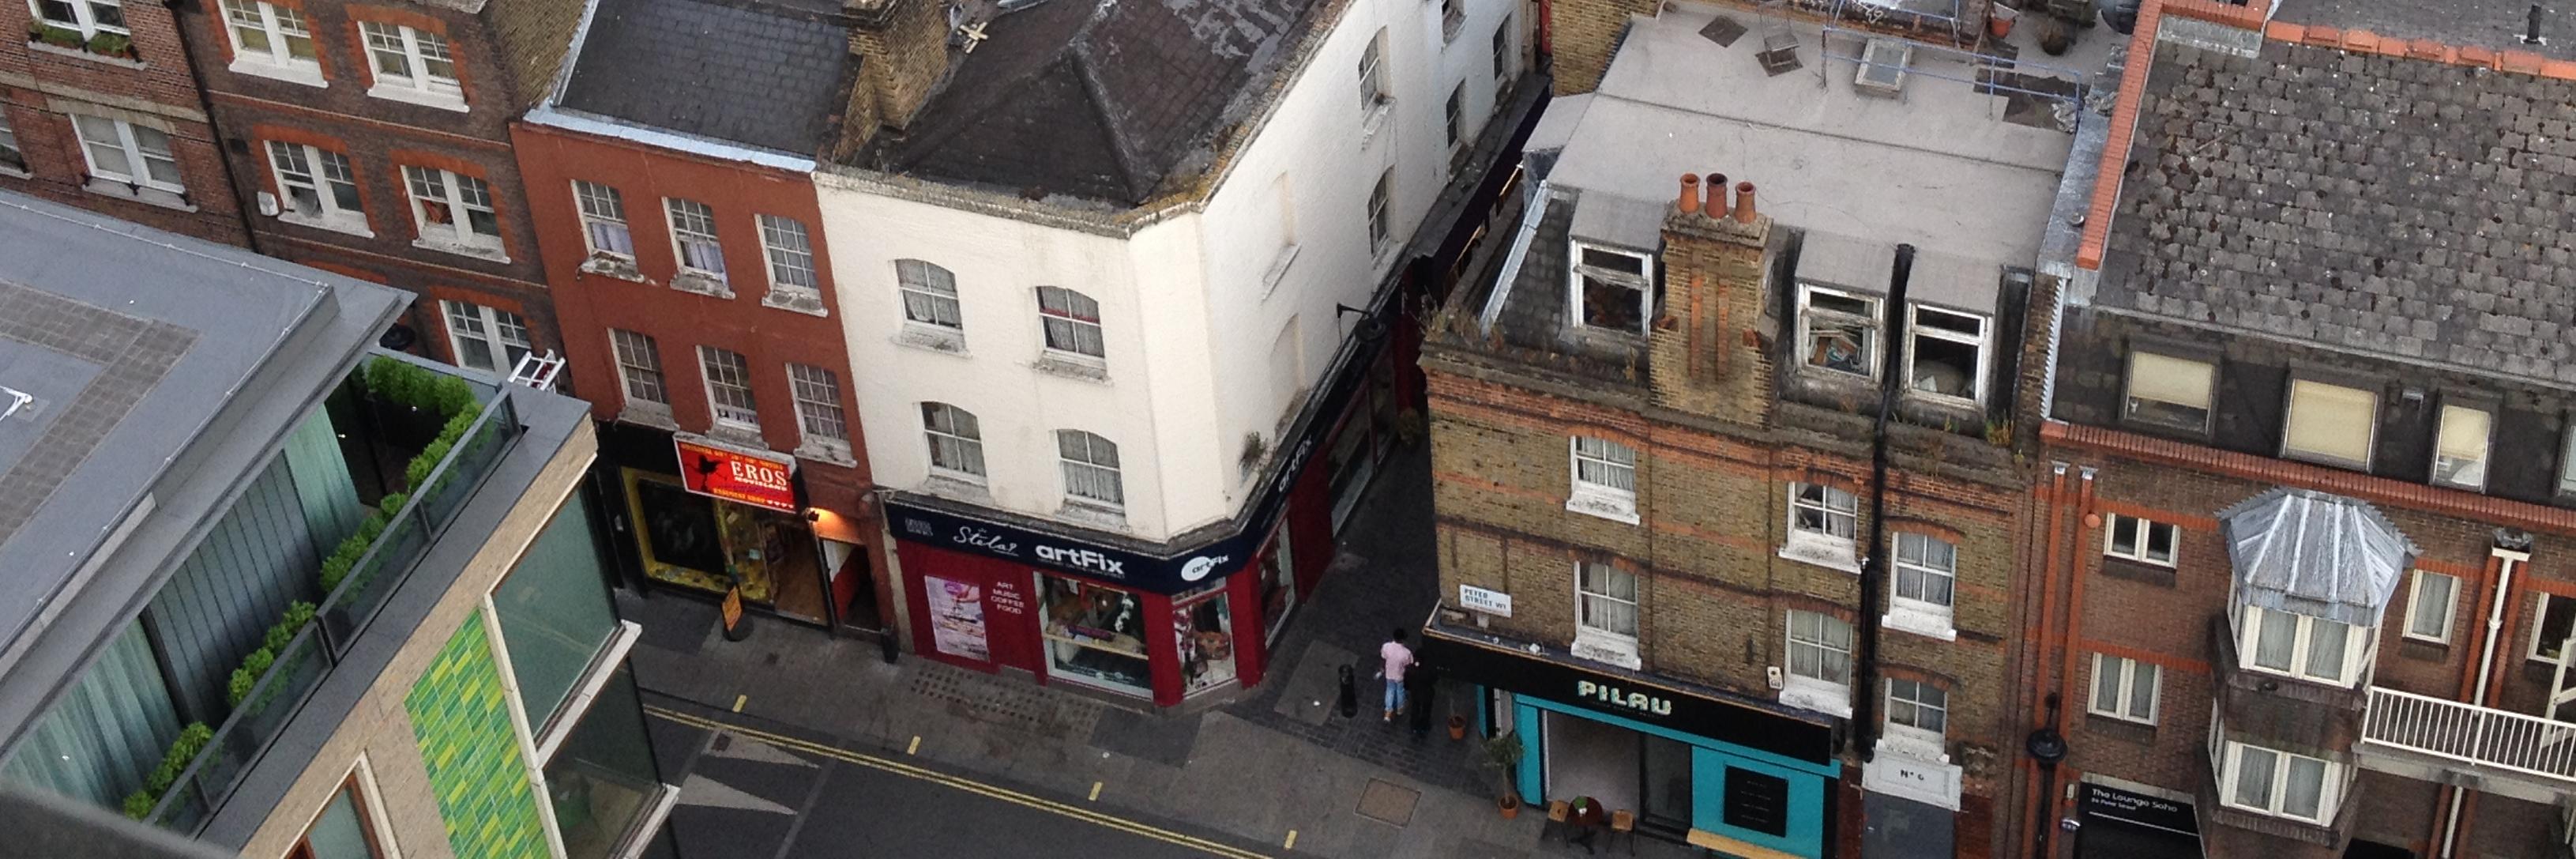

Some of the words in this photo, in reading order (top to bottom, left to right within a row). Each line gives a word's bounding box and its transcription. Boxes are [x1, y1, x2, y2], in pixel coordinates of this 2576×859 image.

[1278, 434, 1311, 492] artFix
[730, 460, 787, 487] EROS
[1036, 544, 1124, 575] artFix
[997, 581, 1013, 590] ART
[992, 588, 1021, 600] MUSIC
[1465, 588, 1488, 599] PETER
[990, 595, 1025, 608] COFFEE
[1465, 595, 1492, 607] STREET
[997, 604, 1022, 615] FOOD
[1578, 680, 1672, 715] PILAU
[2091, 788, 2110, 798] The
[2112, 793, 2149, 808] Lounge
[2152, 801, 2178, 812] Soho
